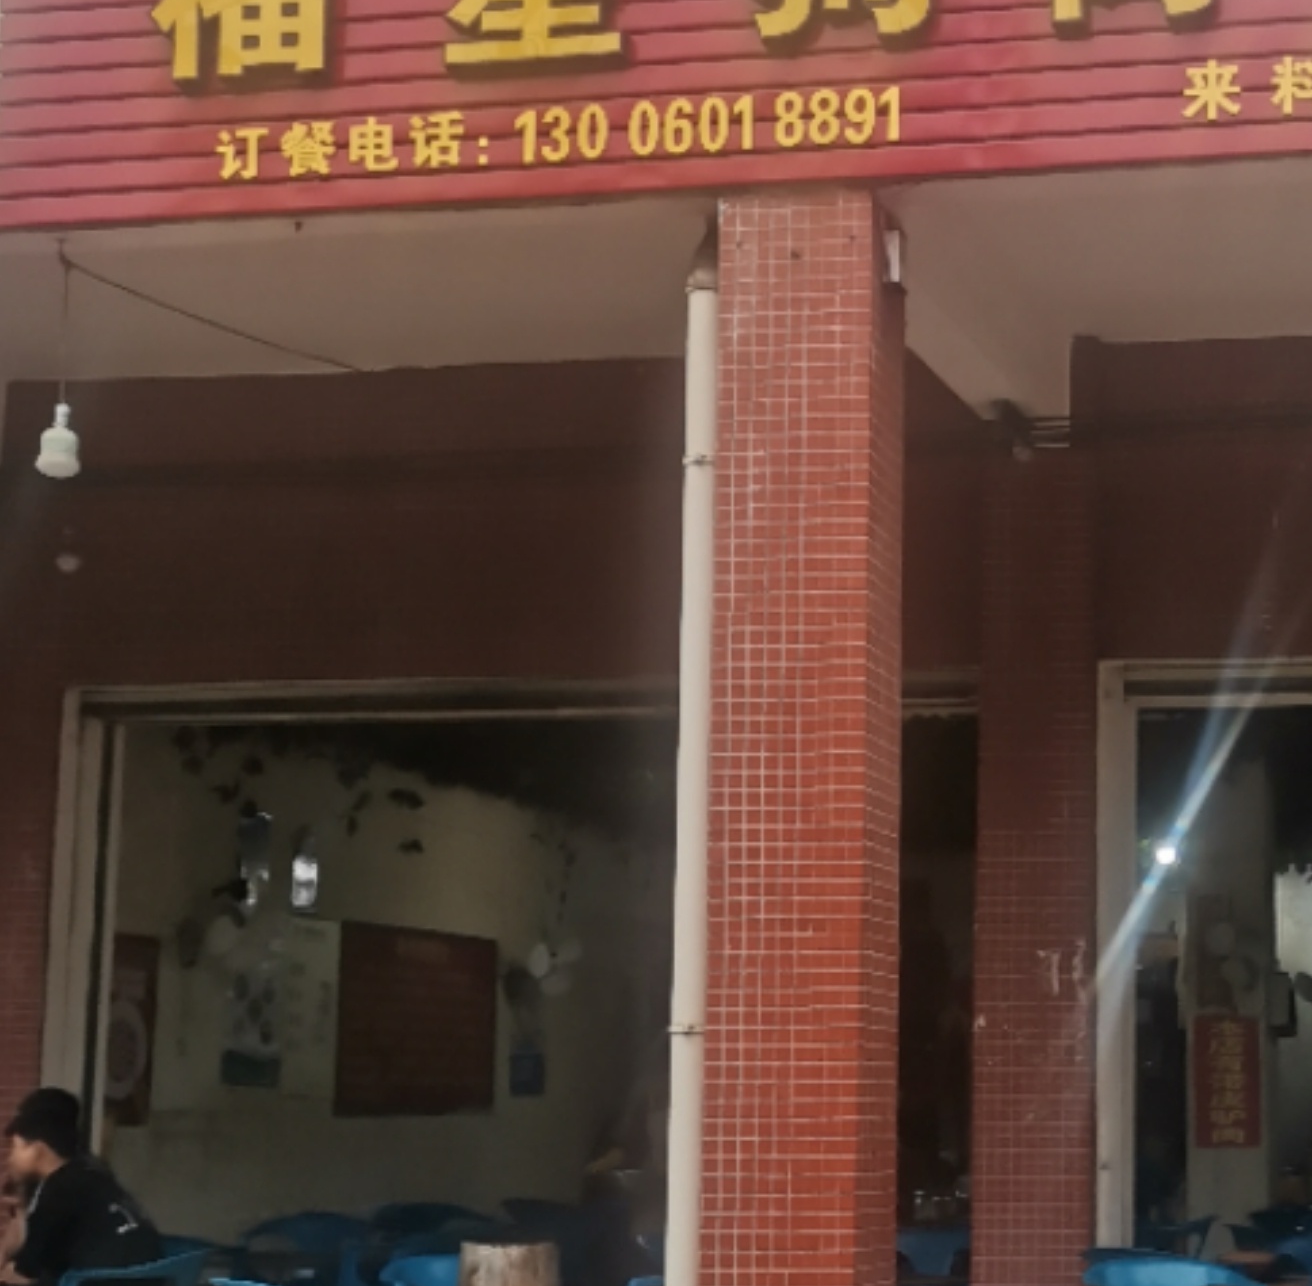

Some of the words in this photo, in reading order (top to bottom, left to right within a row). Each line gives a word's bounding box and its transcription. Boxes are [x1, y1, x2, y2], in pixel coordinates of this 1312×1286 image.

[514, 104, 608, 164] 130
[628, 94, 755, 156] 0601
[774, 86, 901, 148] 8891
